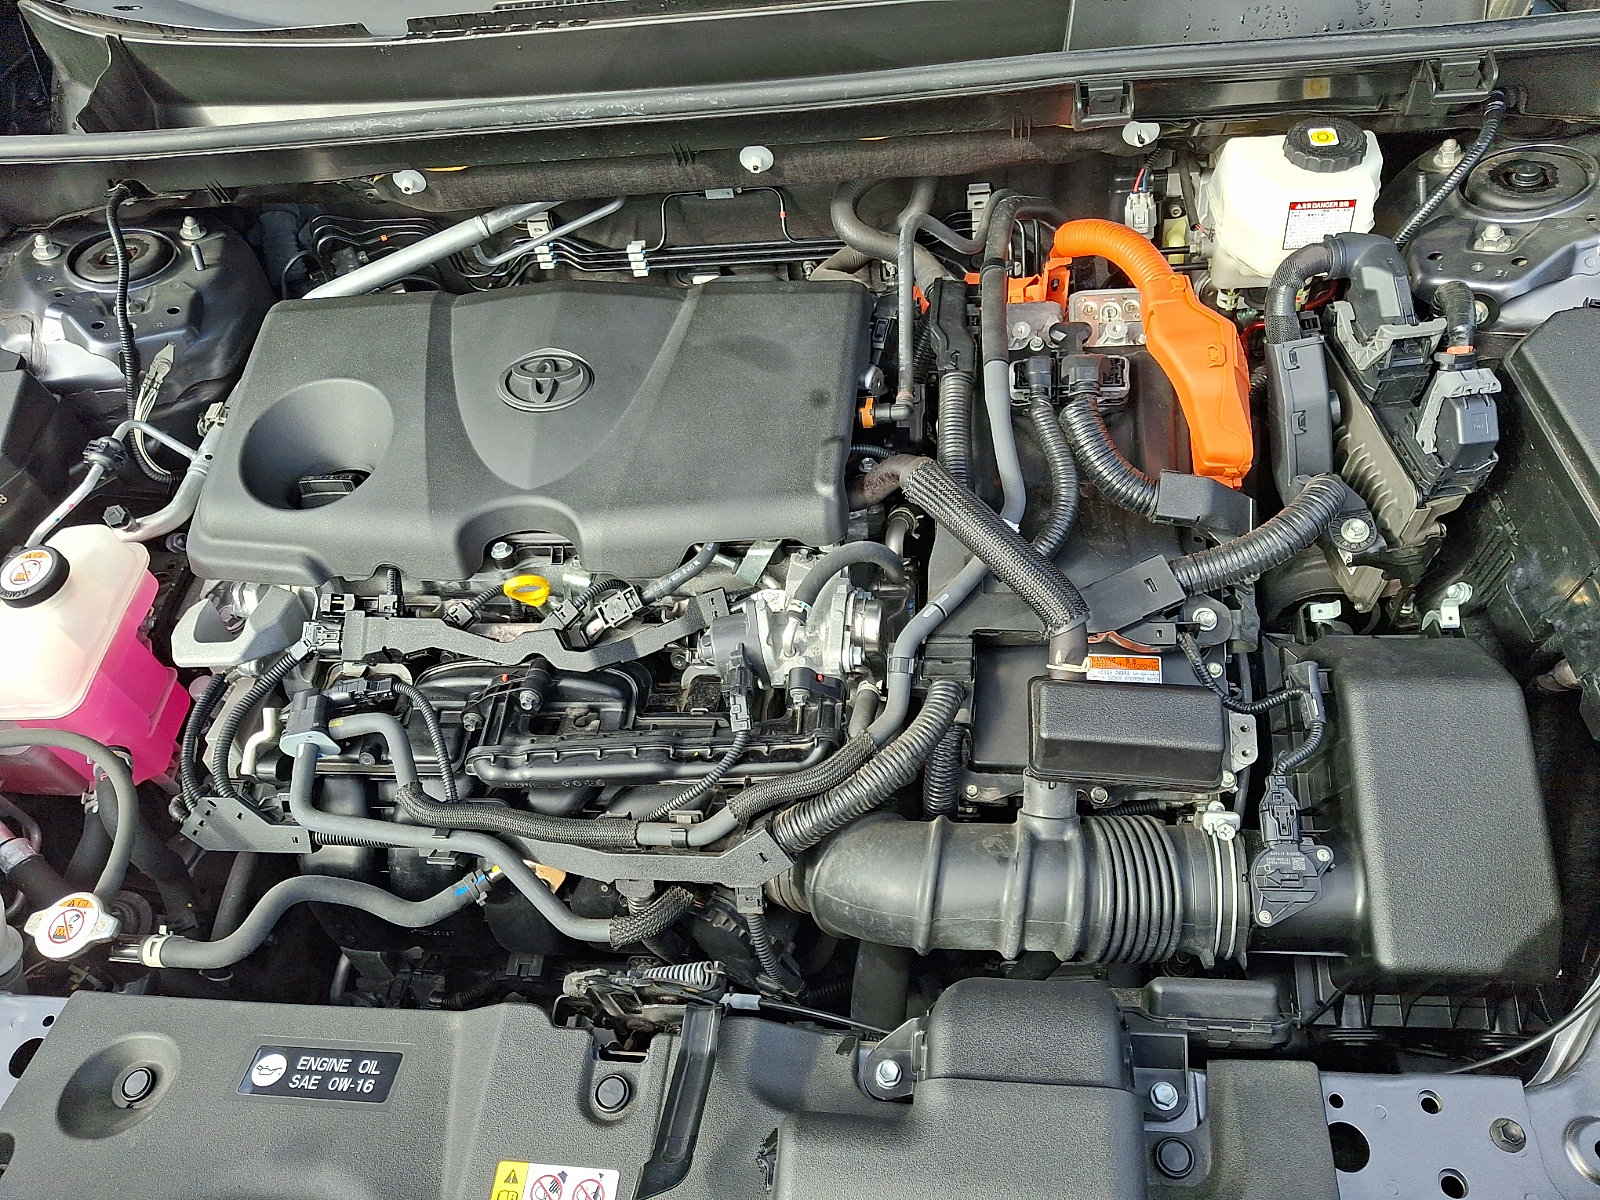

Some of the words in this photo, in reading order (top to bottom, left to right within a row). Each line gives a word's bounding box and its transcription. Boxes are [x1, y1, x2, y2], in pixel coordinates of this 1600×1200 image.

[1311, 201, 1339, 209] DANGER
[297, 1056, 352, 1073] ENGINE
[358, 1059, 381, 1075] OIL
[288, 1075, 322, 1090] SAE
[328, 1078, 375, 1093] 0W-16
